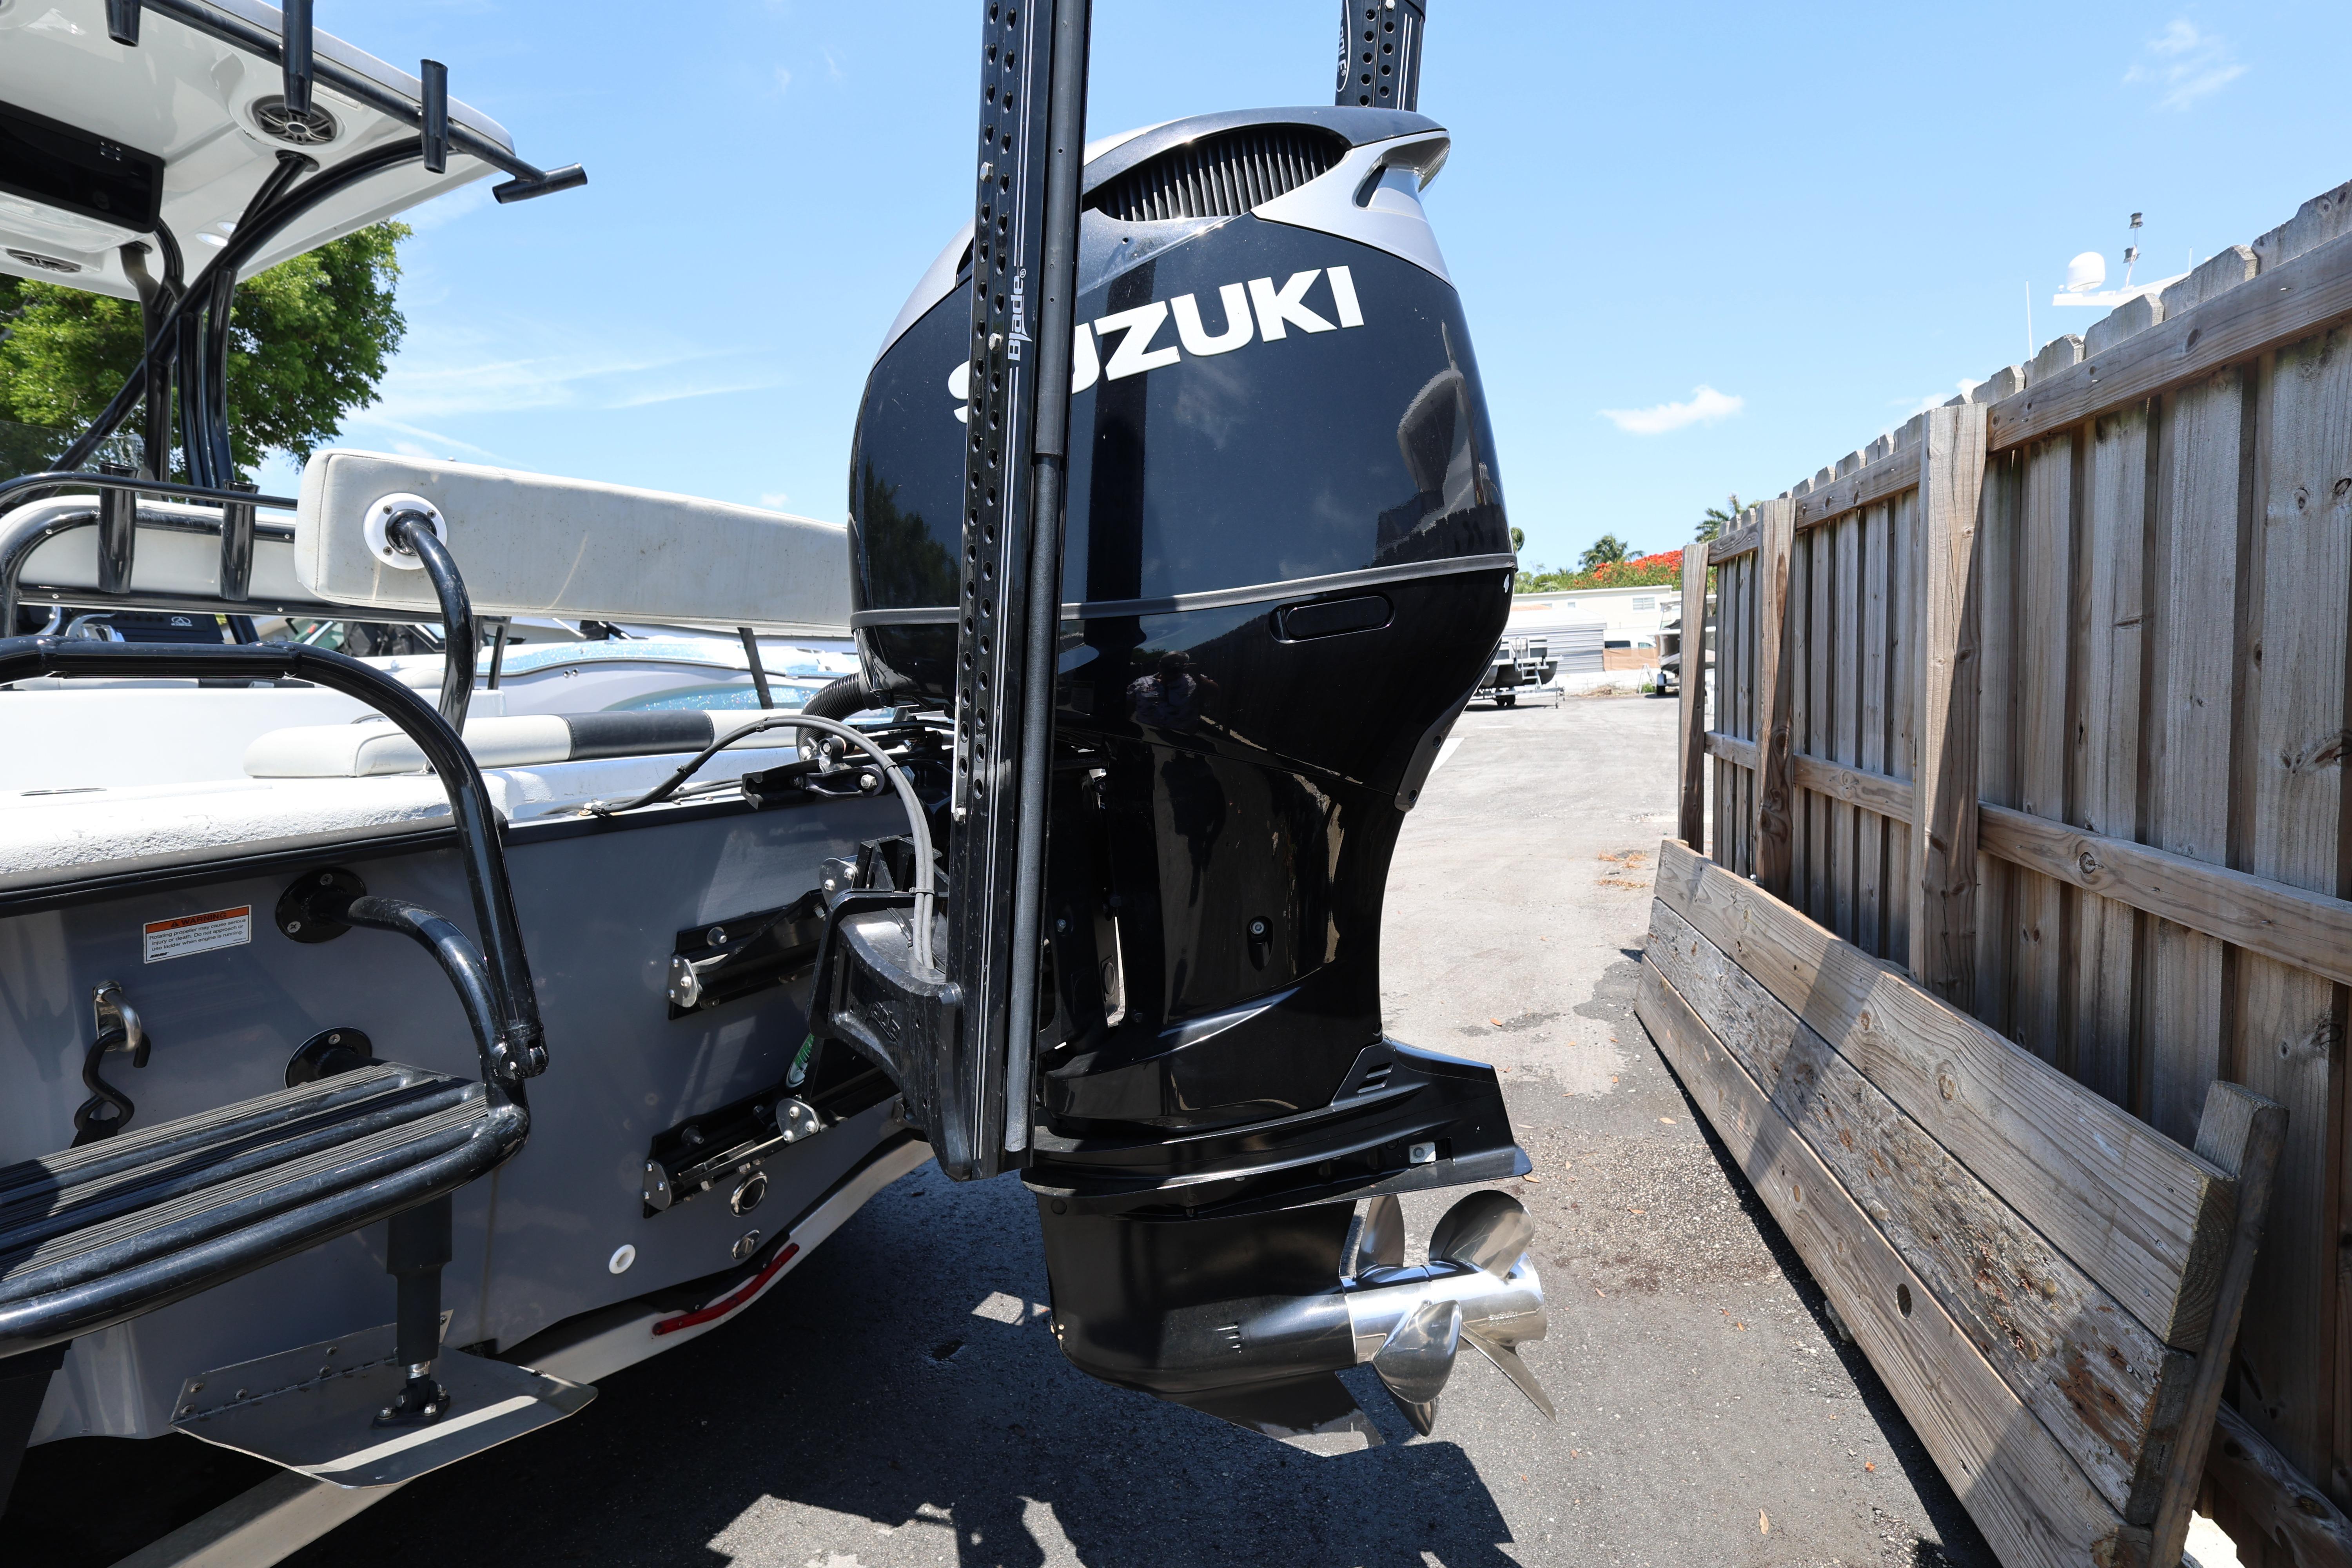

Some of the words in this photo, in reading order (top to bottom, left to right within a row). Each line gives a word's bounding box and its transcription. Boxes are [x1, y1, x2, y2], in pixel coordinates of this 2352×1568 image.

[948, 265, 1364, 424] ZUKI
[181, 912, 226, 926] WARNING
[174, 928, 197, 936] propeller
[213, 926, 237, 934] approach
